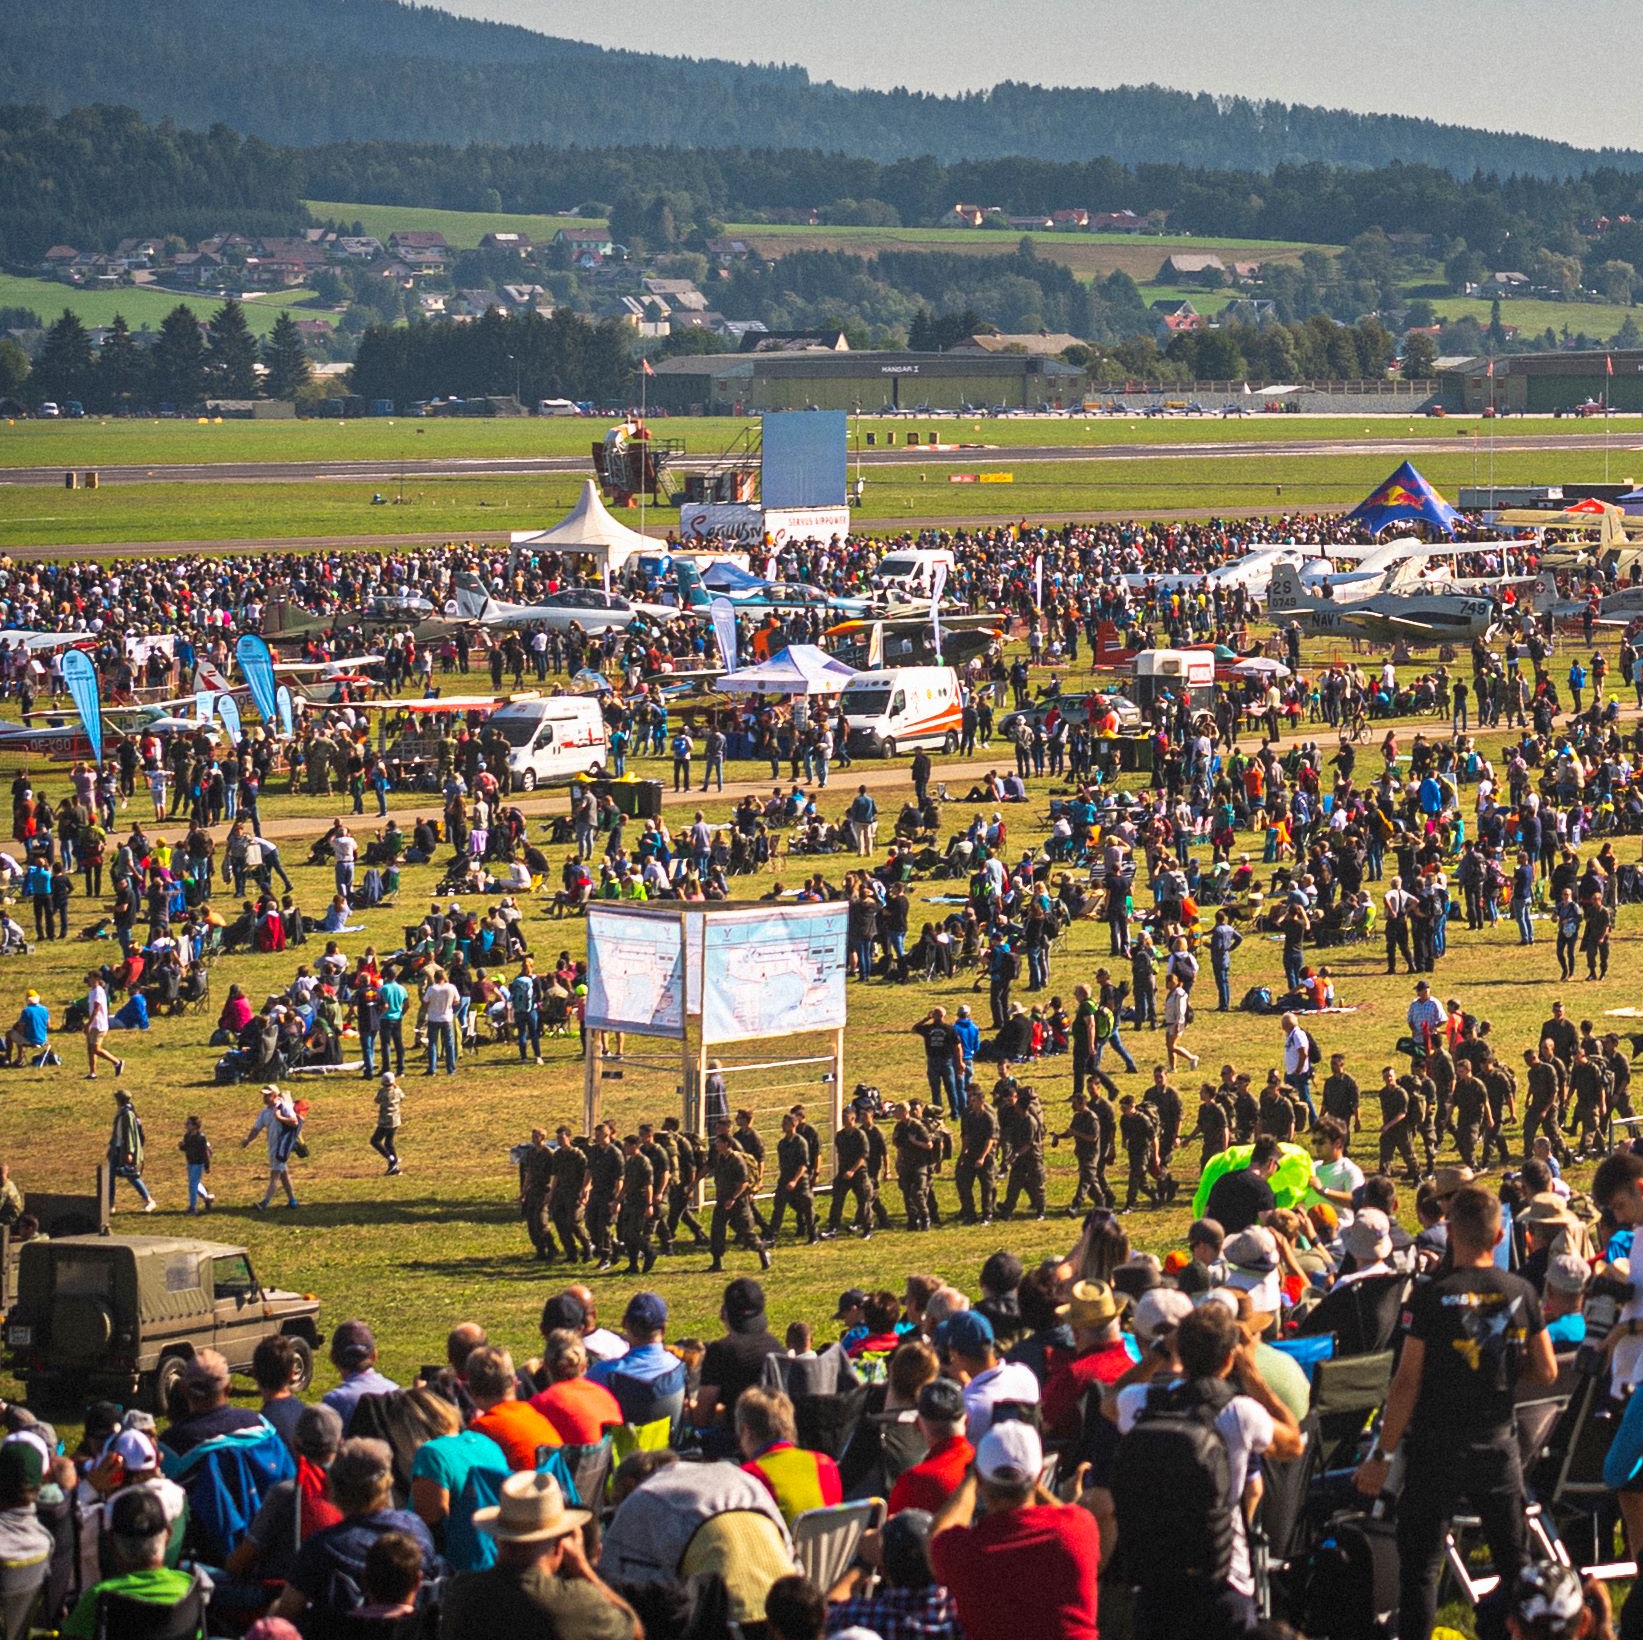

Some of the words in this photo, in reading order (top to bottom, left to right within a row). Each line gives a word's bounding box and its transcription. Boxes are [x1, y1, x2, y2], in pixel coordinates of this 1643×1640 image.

[881, 365, 912, 373] HANGAR
[788, 516, 814, 526] SERVUS
[815, 515, 847, 526] AIRPOWER
[1272, 580, 1292, 594] 2S
[1272, 596, 1297, 608] 0749
[1460, 600, 1488, 616] 749
[1311, 613, 1342, 628] NAVY
